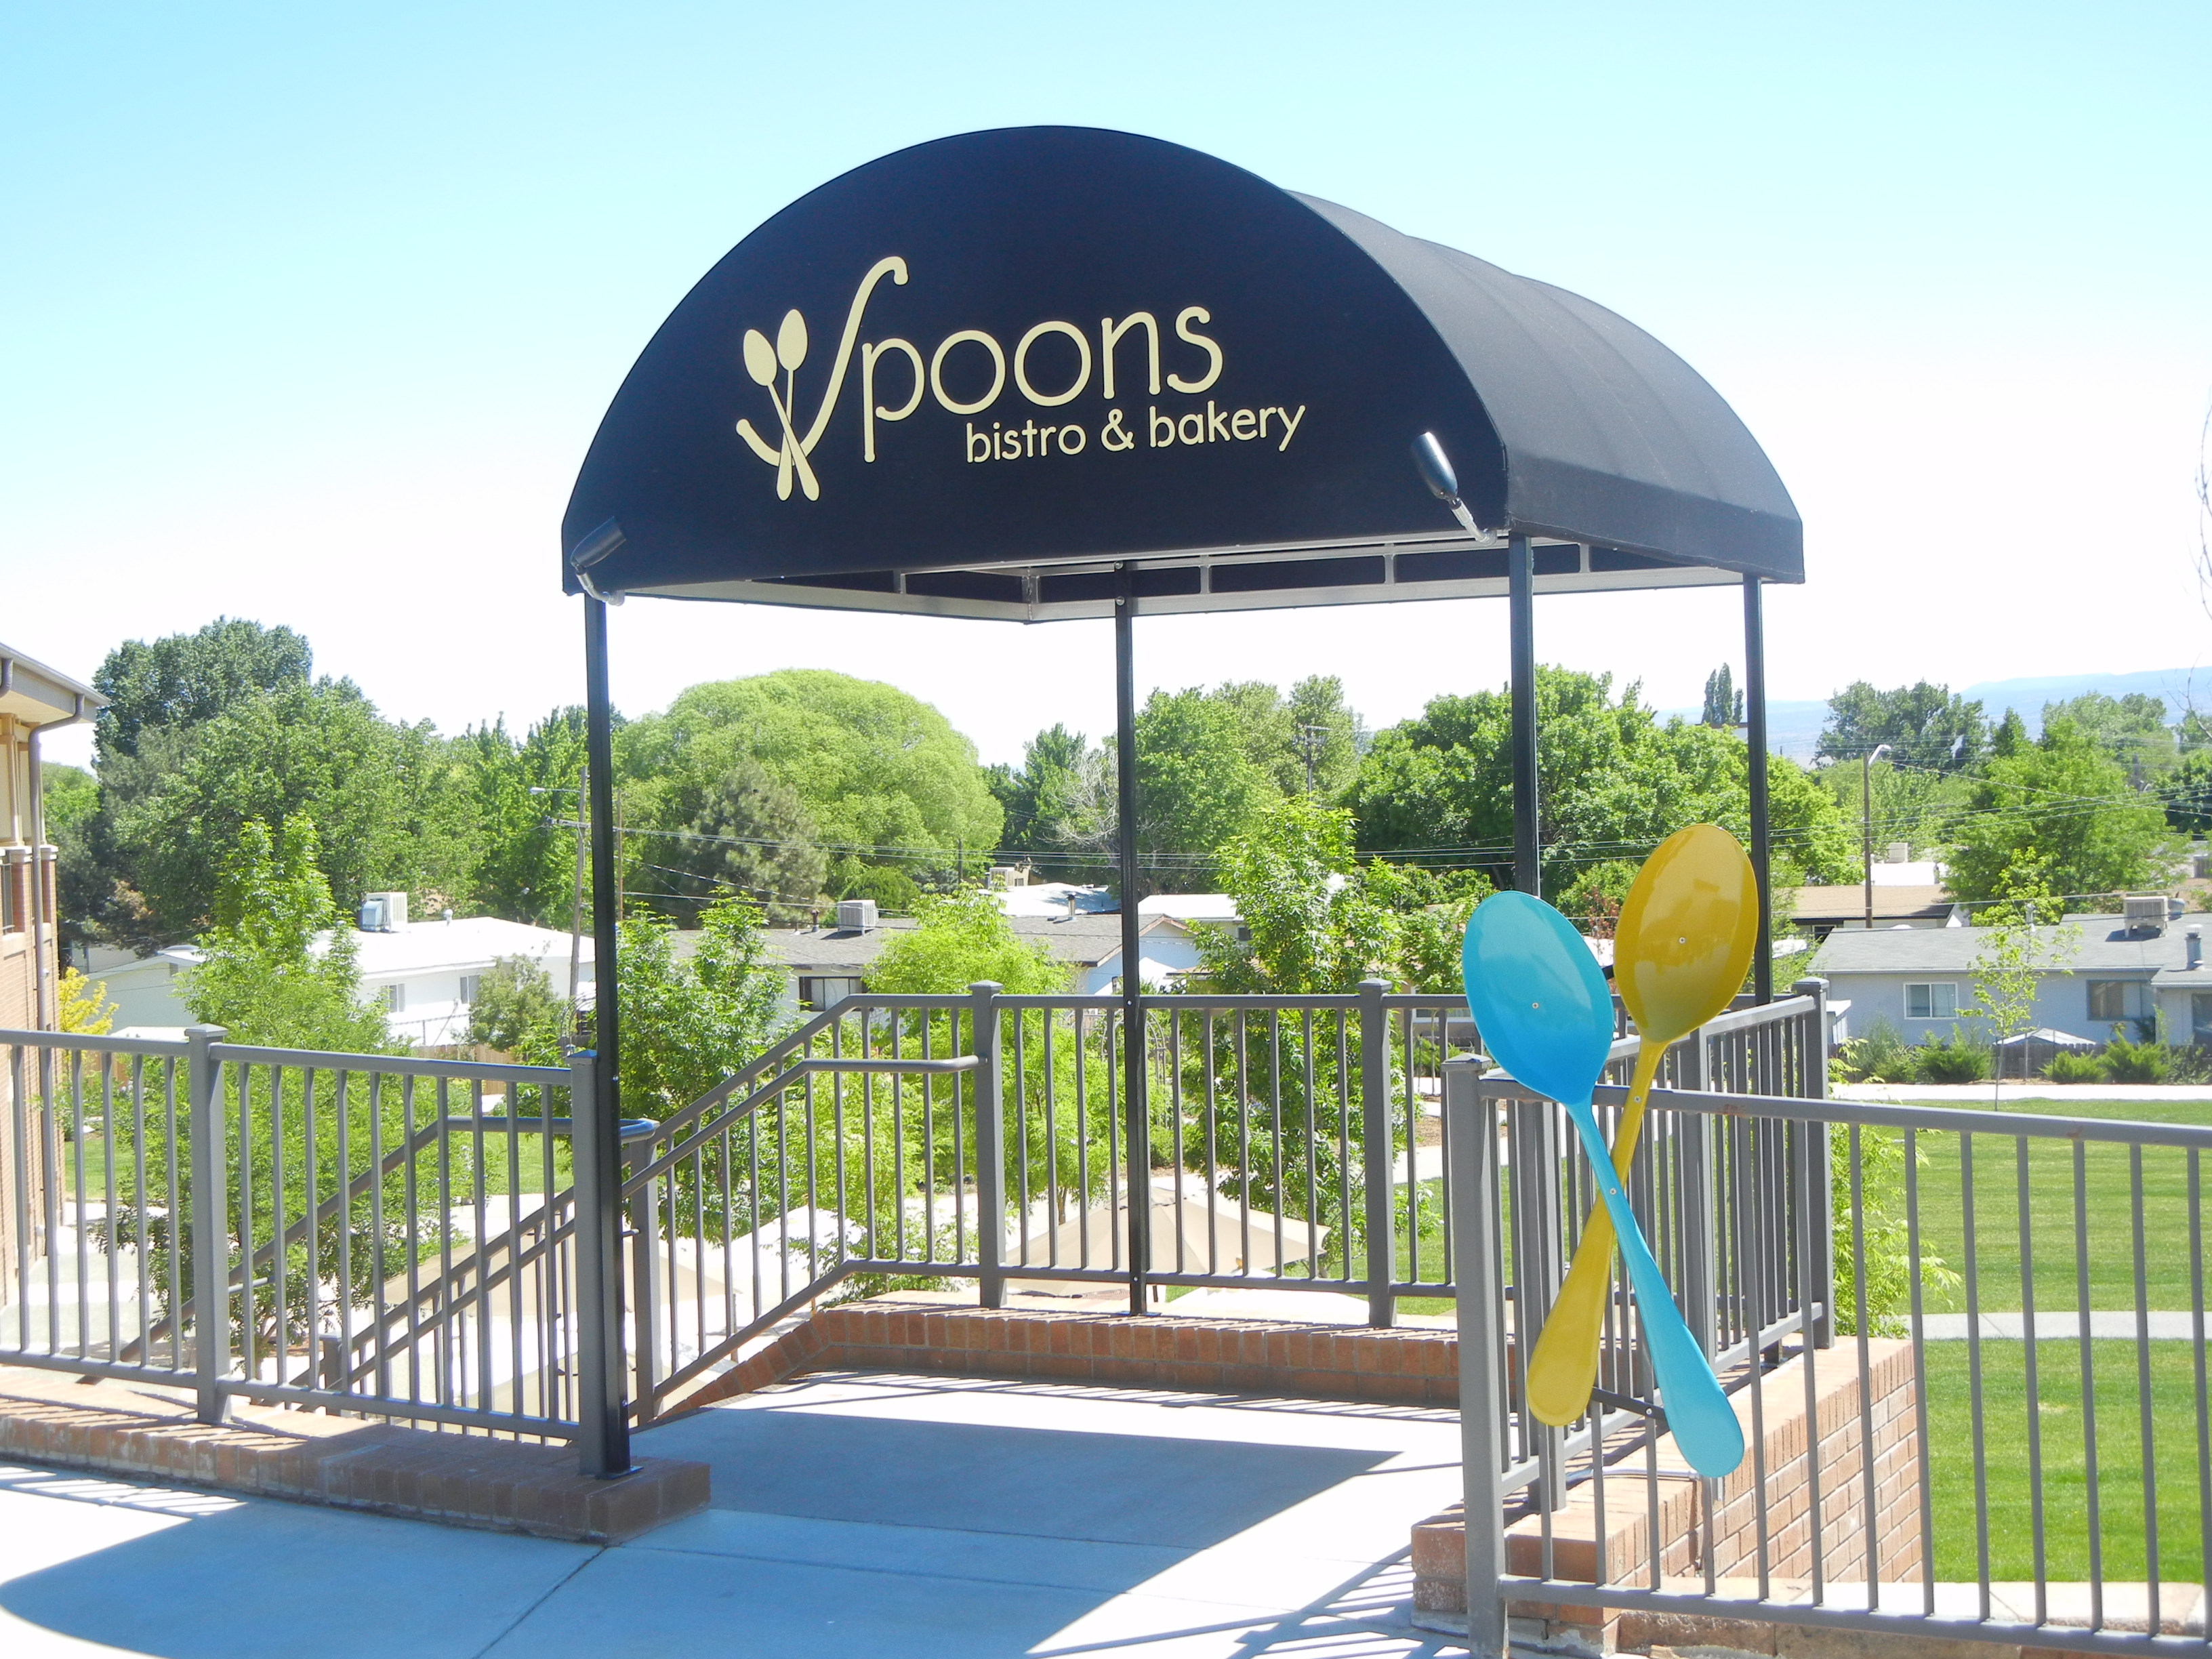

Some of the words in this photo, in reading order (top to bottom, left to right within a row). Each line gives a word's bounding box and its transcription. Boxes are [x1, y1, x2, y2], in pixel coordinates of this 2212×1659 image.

[736, 255, 1223, 468] Spoons
[966, 419, 1086, 463] bistro
[1101, 409, 1135, 451] &
[1149, 400, 1306, 452] bakery
